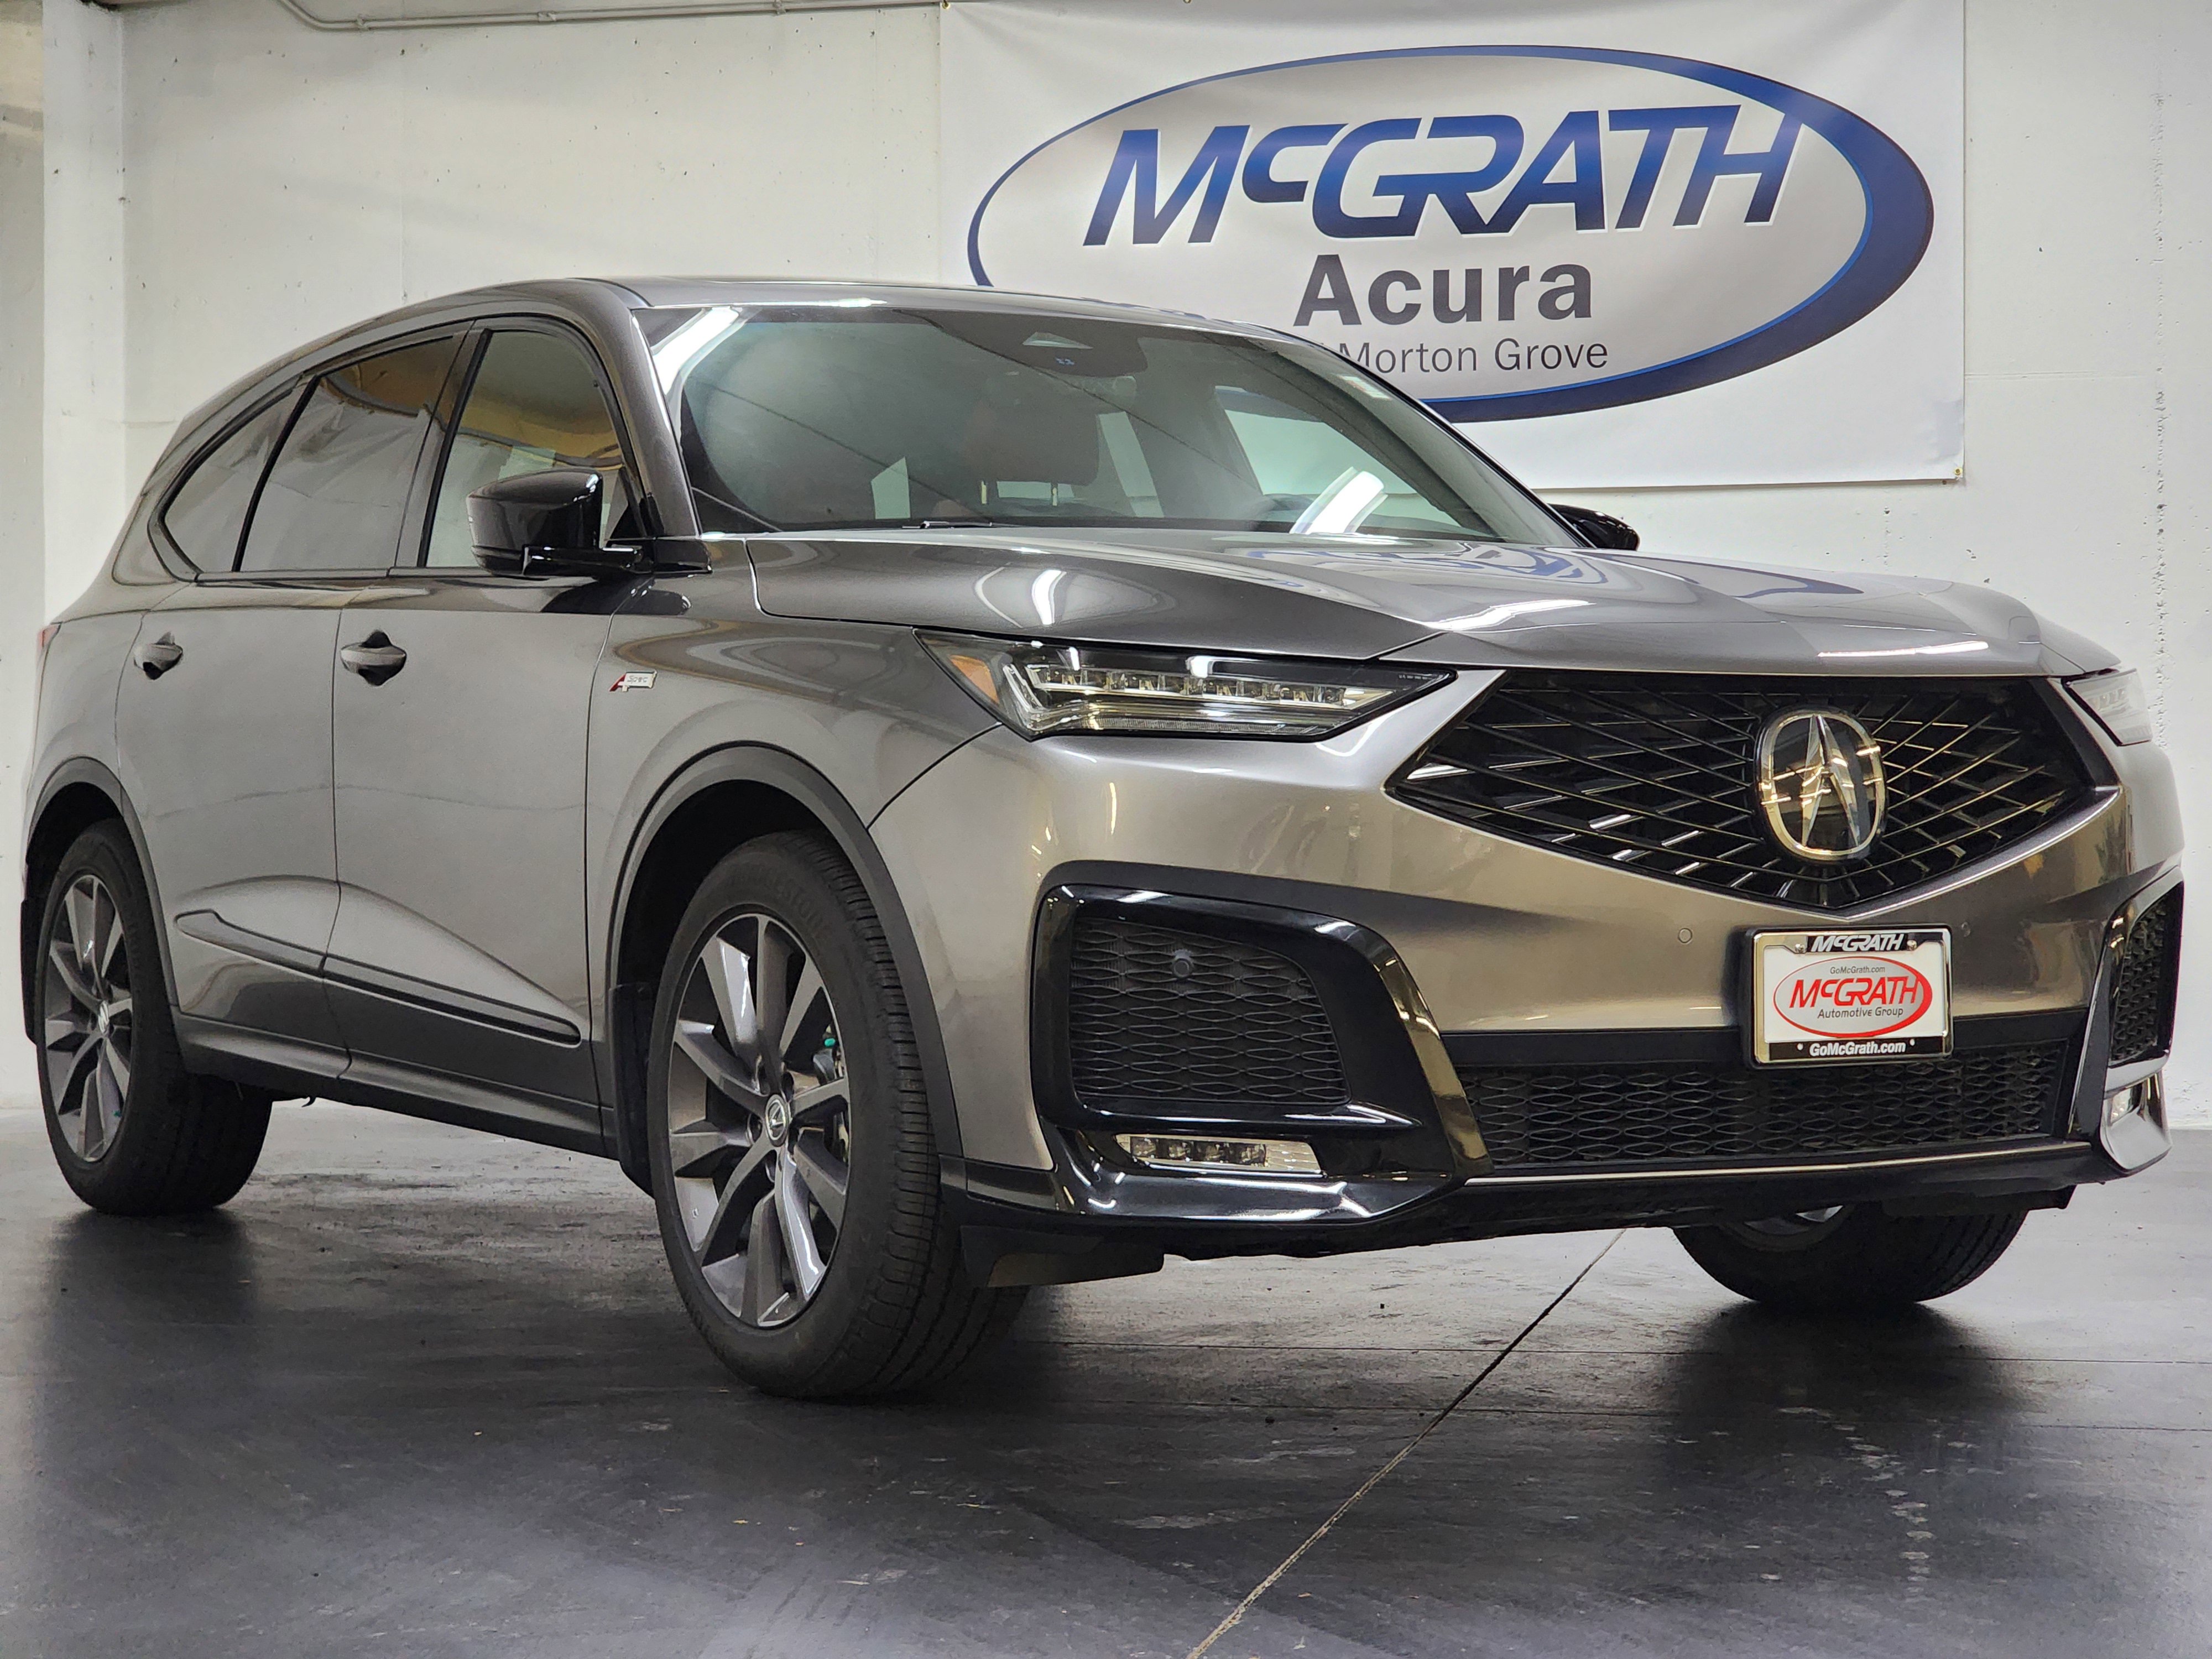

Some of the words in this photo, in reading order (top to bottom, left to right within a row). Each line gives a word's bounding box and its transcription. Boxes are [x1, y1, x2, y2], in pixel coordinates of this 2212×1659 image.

[1293, 253, 1592, 326] Acura
[1494, 337, 1608, 371] Grove
[1830, 966, 1885, 974] GoMcGrath.com
[1817, 1008, 1872, 1019] Automotive
[1875, 1007, 1903, 1018] Group
[1809, 1041, 1906, 1056] GoMcGrath.com
